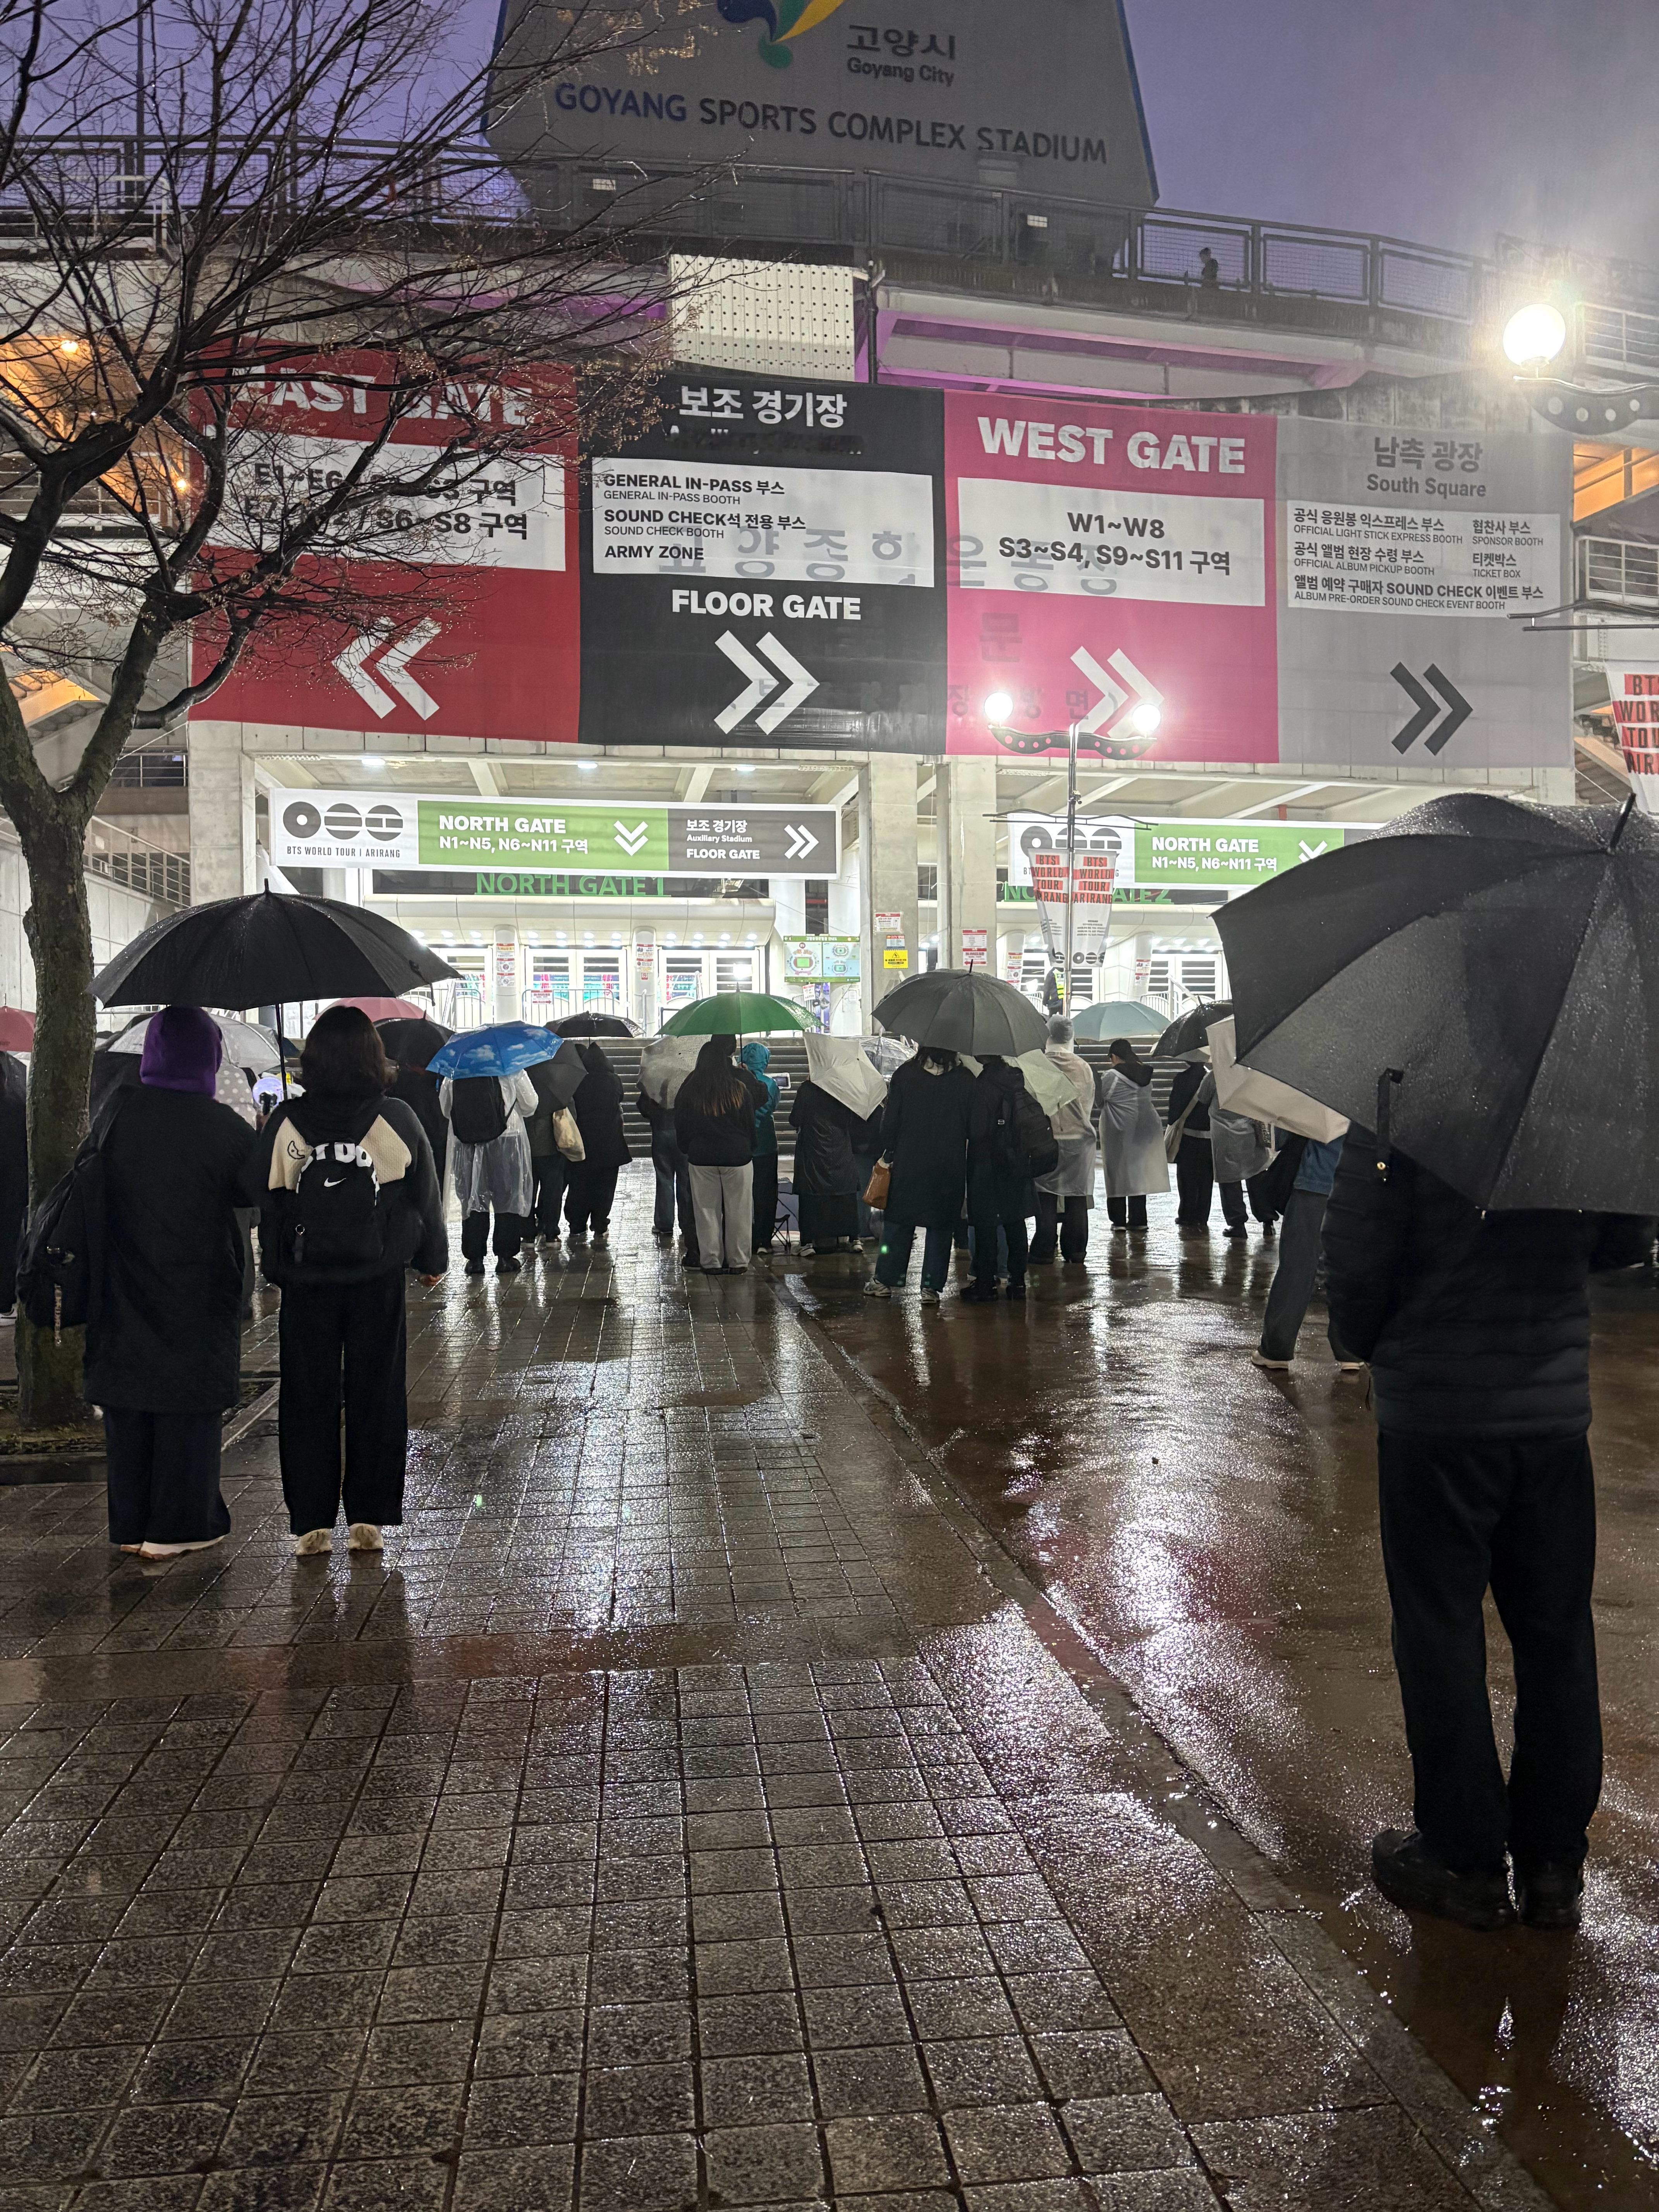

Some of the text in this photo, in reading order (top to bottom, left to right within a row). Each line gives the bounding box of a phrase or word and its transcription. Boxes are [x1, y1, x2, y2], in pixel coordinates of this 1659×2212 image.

[847, 24, 956, 60] 고양시
[847, 57, 955, 87] Goyang City
[555, 82, 1107, 164] GOYANG SPORTS COMPLEX STADIUM
[679, 386, 847, 428] 보조 경기장
[977, 417, 1245, 474] WEST GATE
[1375, 436, 1483, 473] 남측 광장
[603, 474, 785, 495] GENERAL IN-PASS 부스
[1367, 474, 1486, 499] South Square
[604, 490, 740, 505] GENERAL IN-PASS BOOTH
[479, 512, 527, 540] 구역
[604, 510, 807, 530] SOUND CHECK석 전용 부스
[1067, 512, 1165, 539] W1~W8
[1294, 508, 1444, 532] 공식 응원봉 익스프레스 부스
[1472, 519, 1530, 535] 협찬사 부스
[605, 526, 724, 539] SOUND CHECK BOOTH
[1294, 525, 1463, 544] OFFICIAL LIGHT STICK EXPRESS BOOTH
[1472, 536, 1543, 546] SPONSOR BOOTH
[605, 546, 704, 560] ARMY ZONE
[999, 537, 1231, 576] S3~S4, S9~S11 구역
[1294, 541, 1424, 564] 공식 앨범 현장 수령 부스
[1473, 553, 1516, 567] 티켓박스
[1294, 558, 1434, 575] OFFICIAL ALBUM PICKUP BOOTH
[1473, 569, 1521, 578] TICKET BOX
[1294, 575, 1544, 600] 앨범 예약 구매자 SOUND CHECK 이벤트 부스
[672, 589, 861, 620] FLOOR GATE
[1294, 591, 1505, 610] ALBUM PRE-ORDER SOUND CHECK EVENT BOOTH
[1633, 674, 1659, 696] BT
[439, 815, 566, 834] NORTH GATE
[686, 819, 747, 833] 보조 경기장
[440, 836, 588, 854] N1~N5, N6~N11 구역
[687, 834, 720, 843] Auxiliary
[1152, 836, 1259, 853] NORTH GATE
[287, 846, 301, 855] BTS
[305, 847, 331, 856] WORLD
[335, 847, 356, 857] TOUR
[366, 848, 400, 858] ARIRANG
[686, 848, 760, 859] FLOOR GATE
[1039, 855, 1056, 865] BTS
[1087, 857, 1103, 867] BTS
[1152, 856, 1277, 872] N1~N5, N6~N11 구역
[1080, 869, 1111, 879] WORLD
[476, 872, 664, 895] NORTH GATE 1
[1083, 881, 1105, 891] TOUR
[1074, 893, 1113, 903] ARIRANG
[1113, 888, 1172, 903] ATE 2
